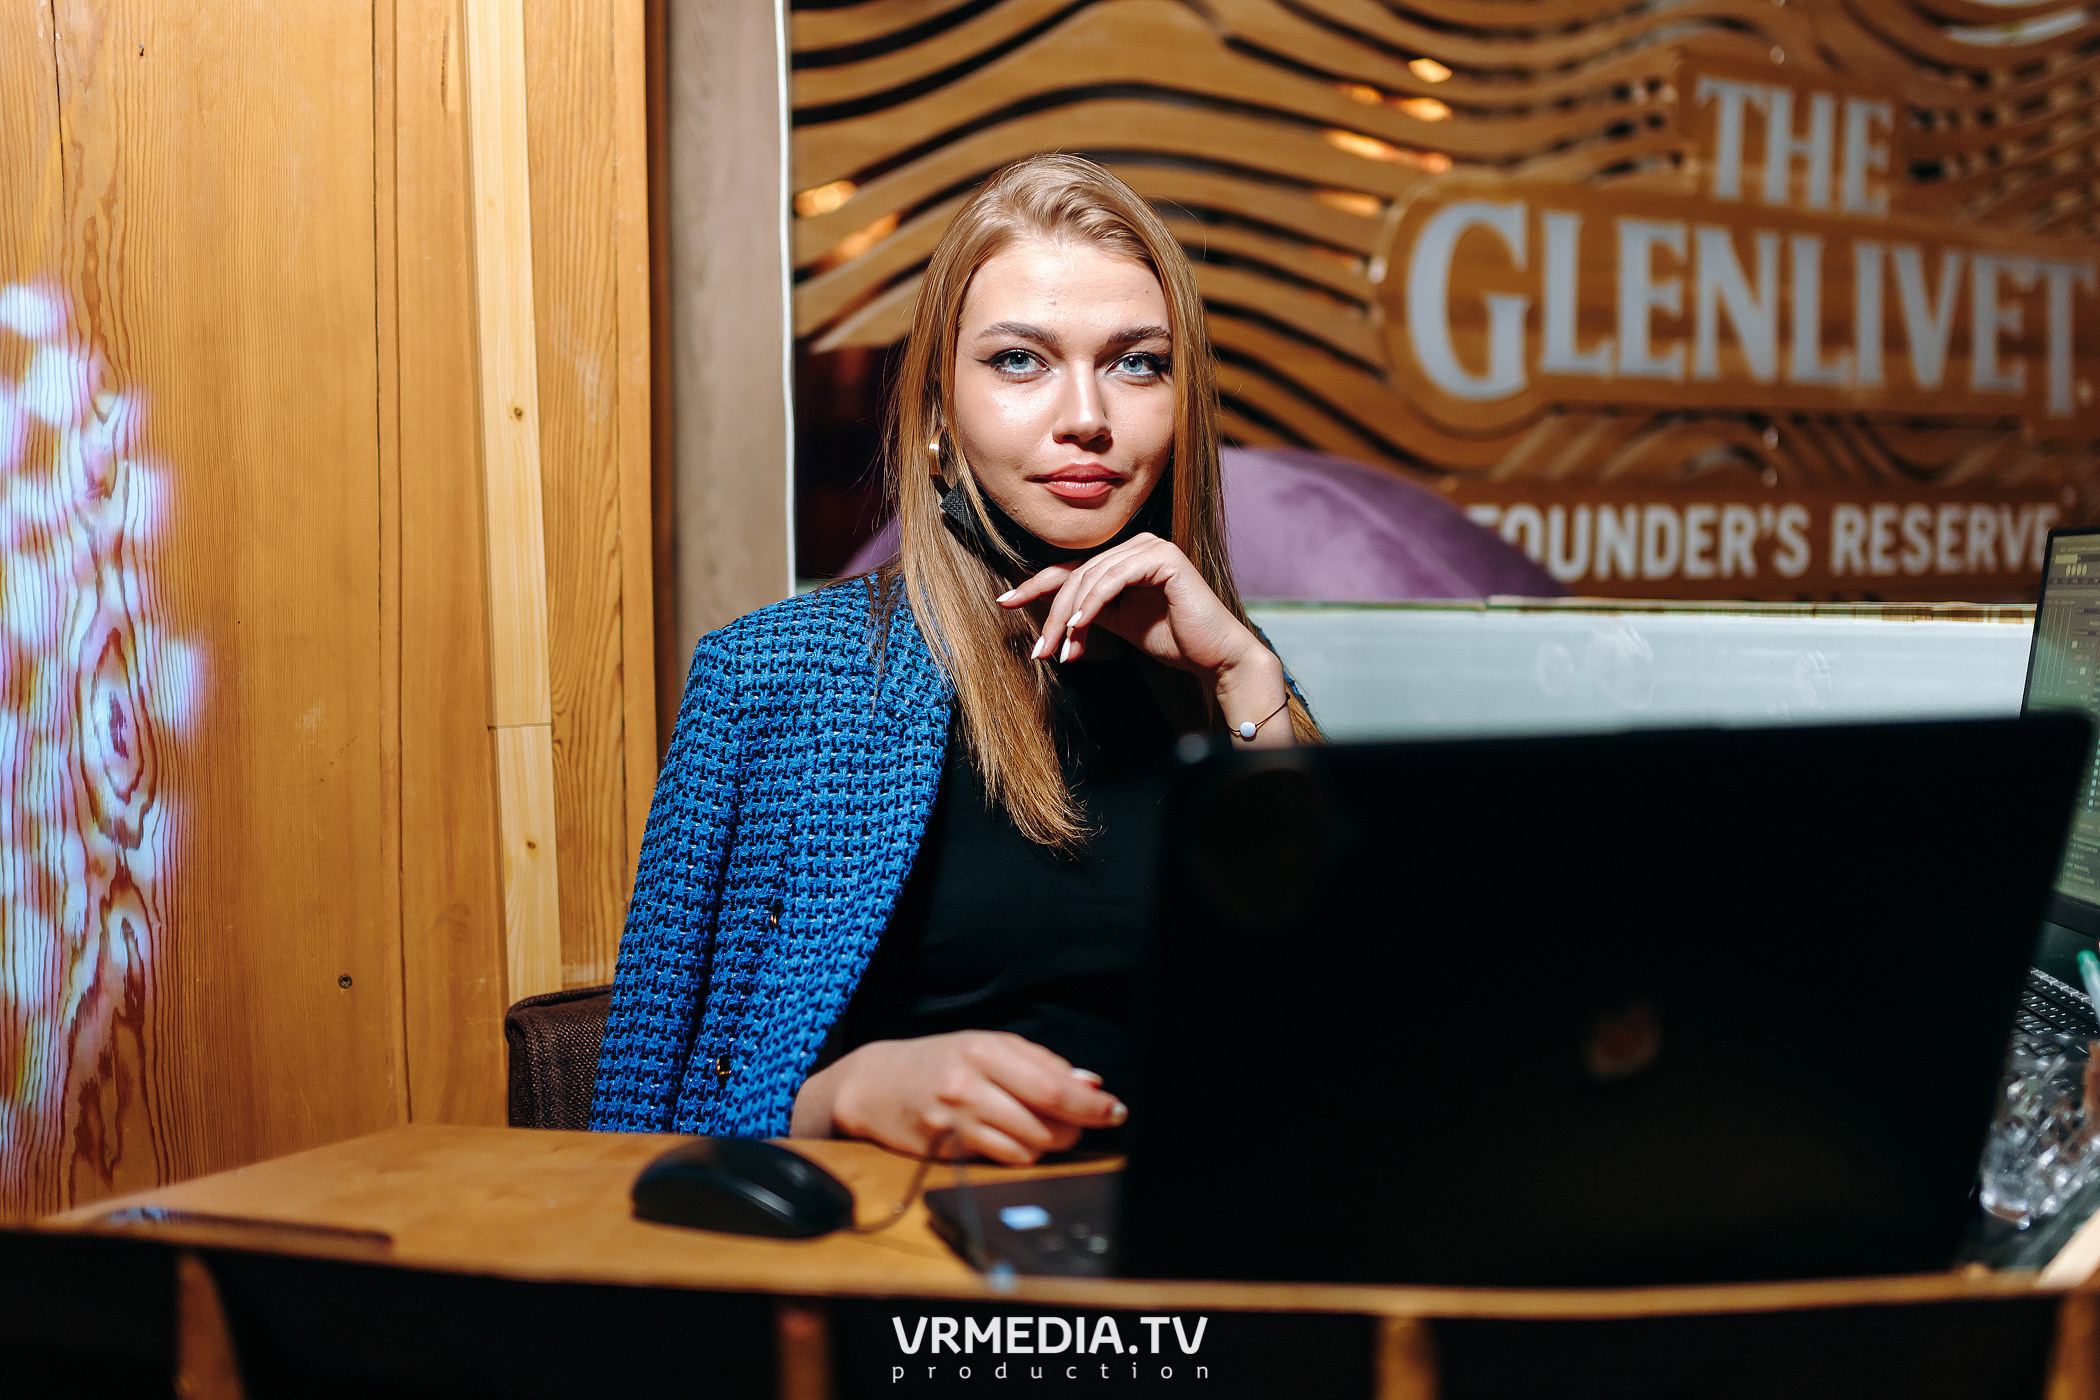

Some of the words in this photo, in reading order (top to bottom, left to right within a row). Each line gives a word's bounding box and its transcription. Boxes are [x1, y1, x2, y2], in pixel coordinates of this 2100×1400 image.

[1696, 75, 1893, 217] THE
[1407, 200, 2097, 418] GLENLIVET
[1466, 503, 1810, 582] OUNDER'S
